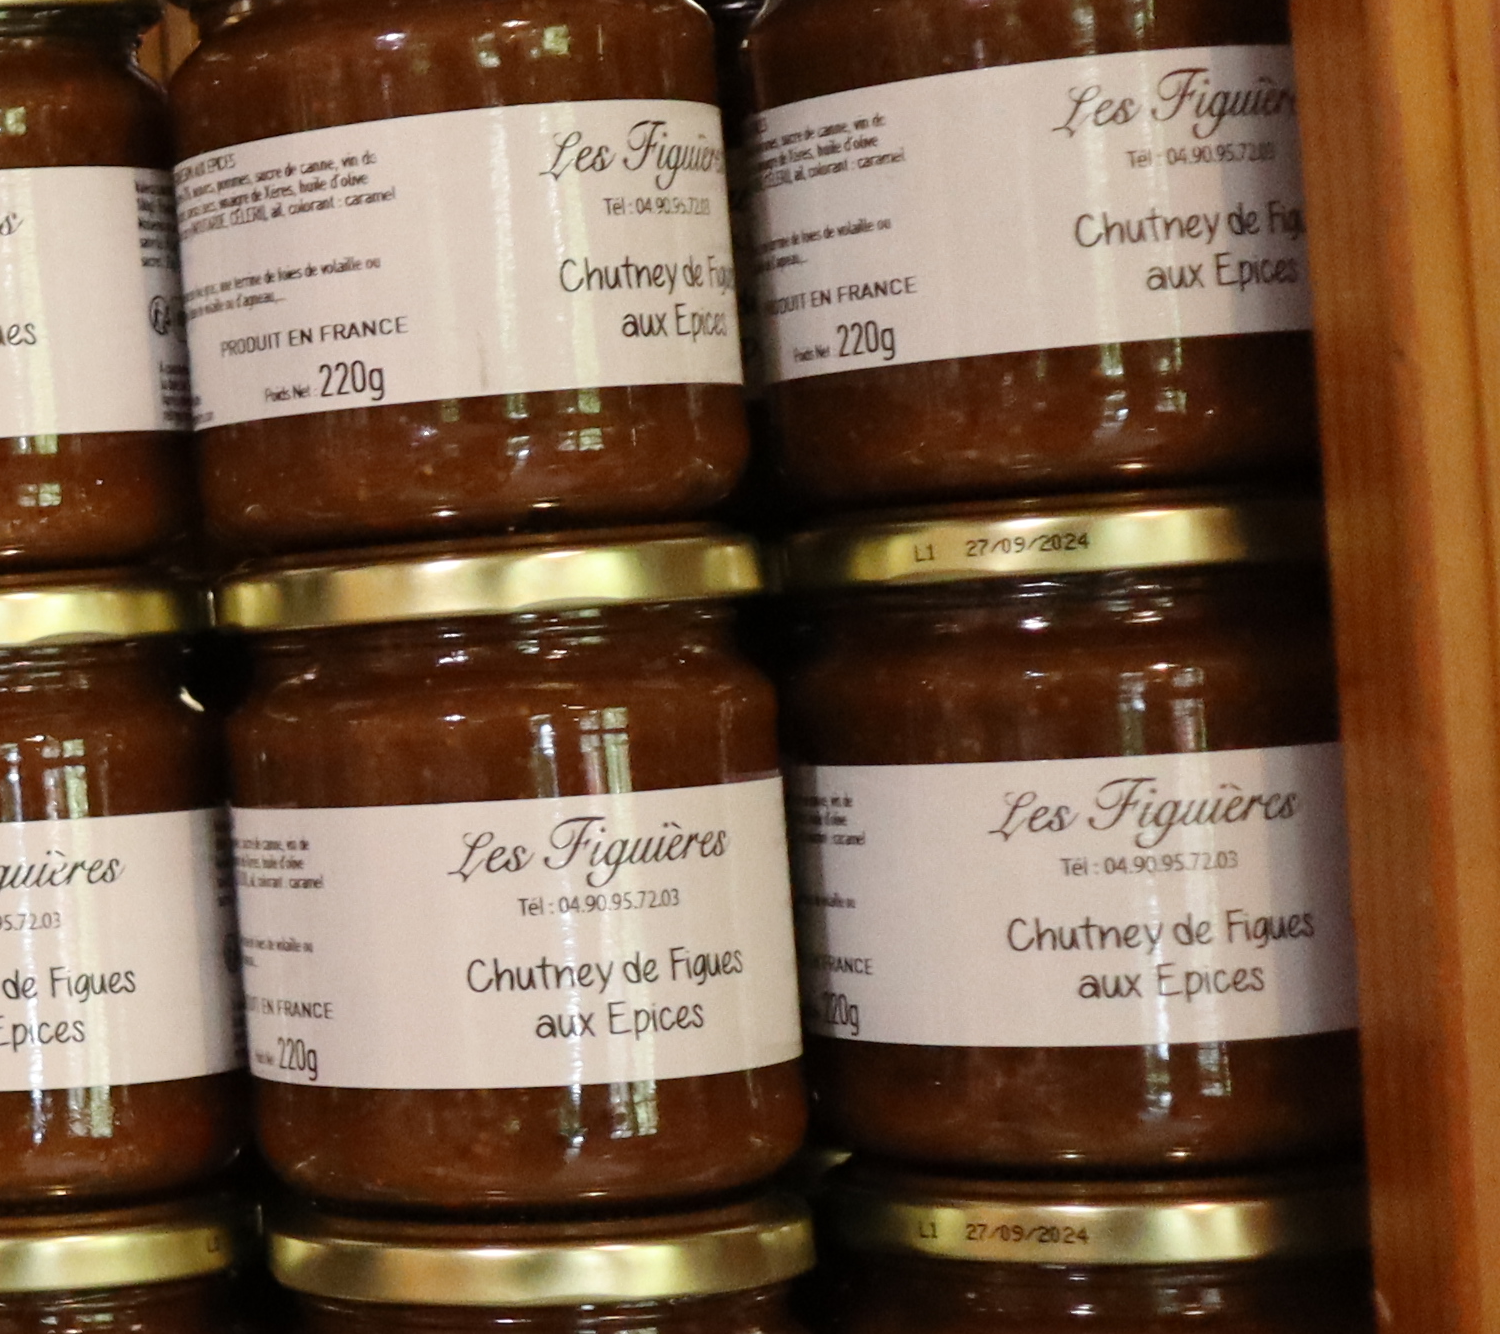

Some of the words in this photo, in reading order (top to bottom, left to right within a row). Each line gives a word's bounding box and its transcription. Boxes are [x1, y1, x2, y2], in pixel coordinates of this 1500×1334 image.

[221, 332, 281, 357] PRODUIT
[289, 329, 313, 346] EN
[320, 316, 409, 342] FRANCE
[319, 360, 385, 401] 220g
[914, 543, 935, 563] L1
[965, 532, 1089, 557] 27/09/2024
[448, 829, 534, 883] Les
[542, 816, 728, 887] Figuières
[466, 959, 615, 995] Chutney
[623, 950, 658, 985] de
[669, 946, 743, 987] Figues
[535, 1011, 595, 1039] aux
[609, 1001, 704, 1041] Epices
[966, 1223, 1089, 1245] 27/09/2024
